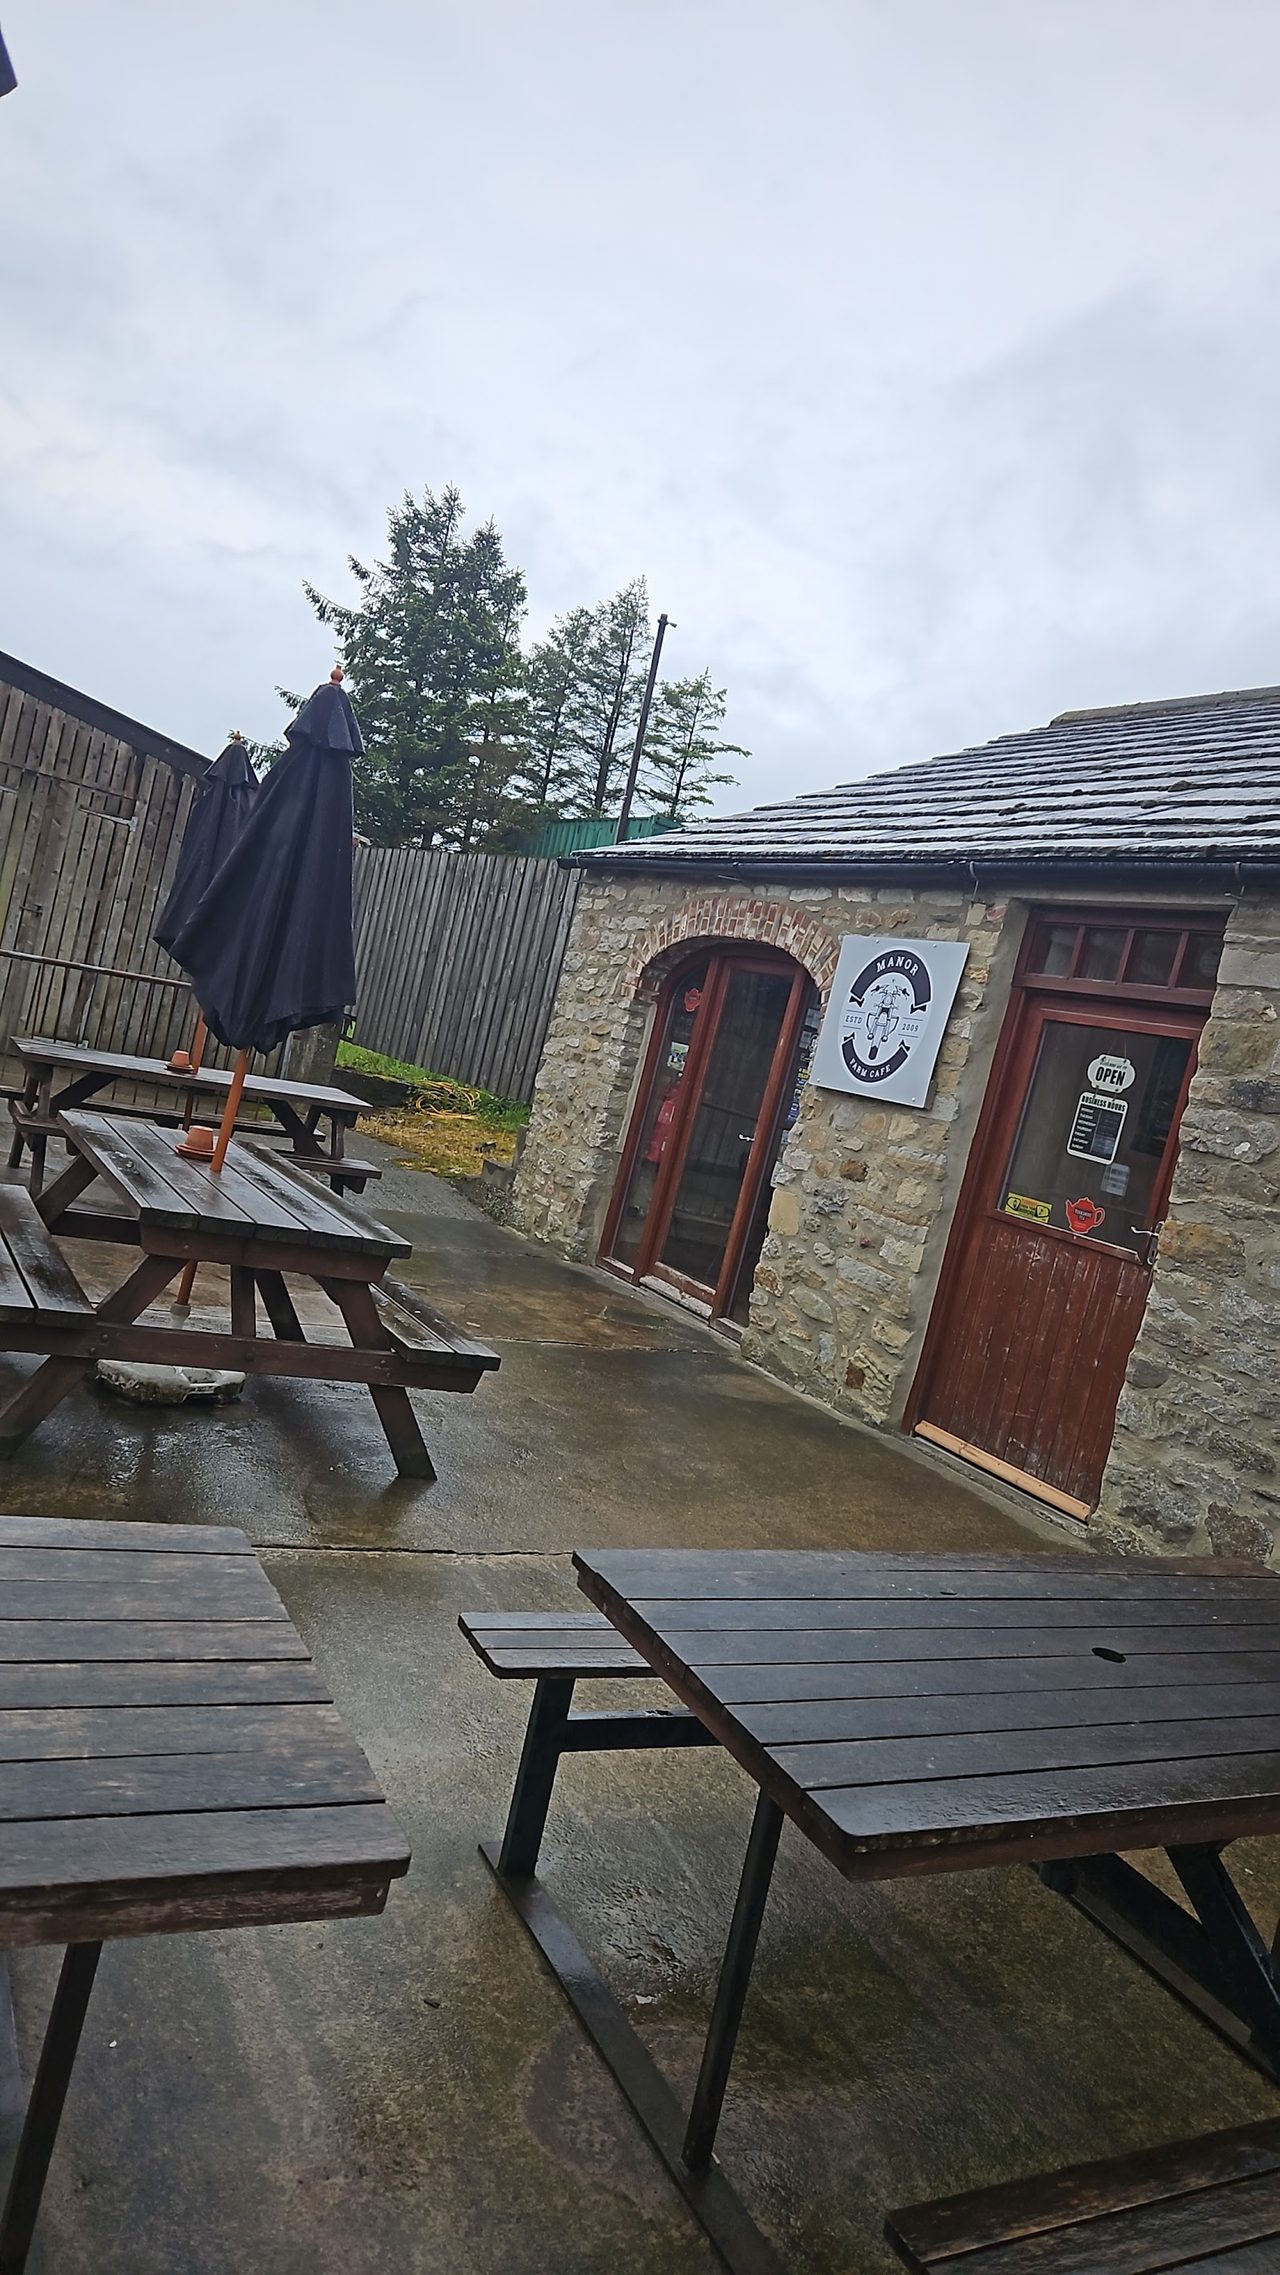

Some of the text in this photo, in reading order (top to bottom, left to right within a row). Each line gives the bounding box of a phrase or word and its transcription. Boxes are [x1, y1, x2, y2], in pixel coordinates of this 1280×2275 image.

[876, 956, 919, 976] MANOR
[845, 1015, 863, 1024] ESTD
[902, 1023, 919, 1033] 2009
[849, 1058, 891, 1078] FARM CAFE
[1095, 1066, 1126, 1087] OPEN
[1081, 1095, 1107, 1108] BUSINESS
